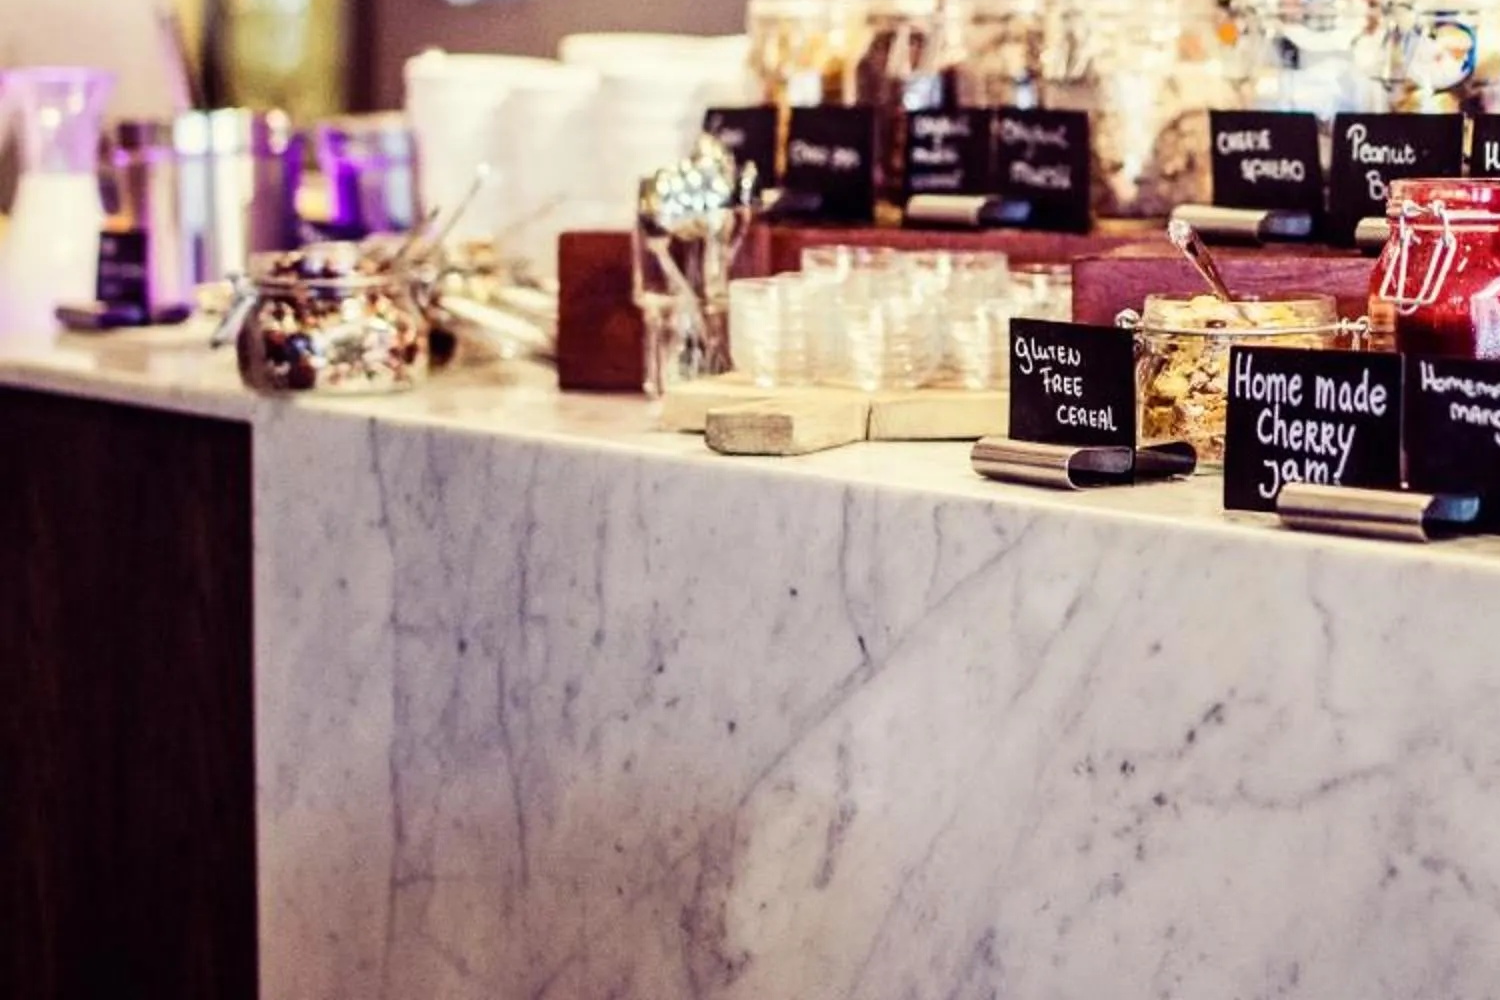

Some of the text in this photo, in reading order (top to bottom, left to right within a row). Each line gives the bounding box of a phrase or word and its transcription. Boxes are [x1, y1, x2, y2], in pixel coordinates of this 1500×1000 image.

[1346, 123, 1417, 165] Peanut
[1039, 366, 1083, 397] FREE
[1235, 351, 1388, 417] Home made
[1056, 404, 1118, 432] CEREAL
